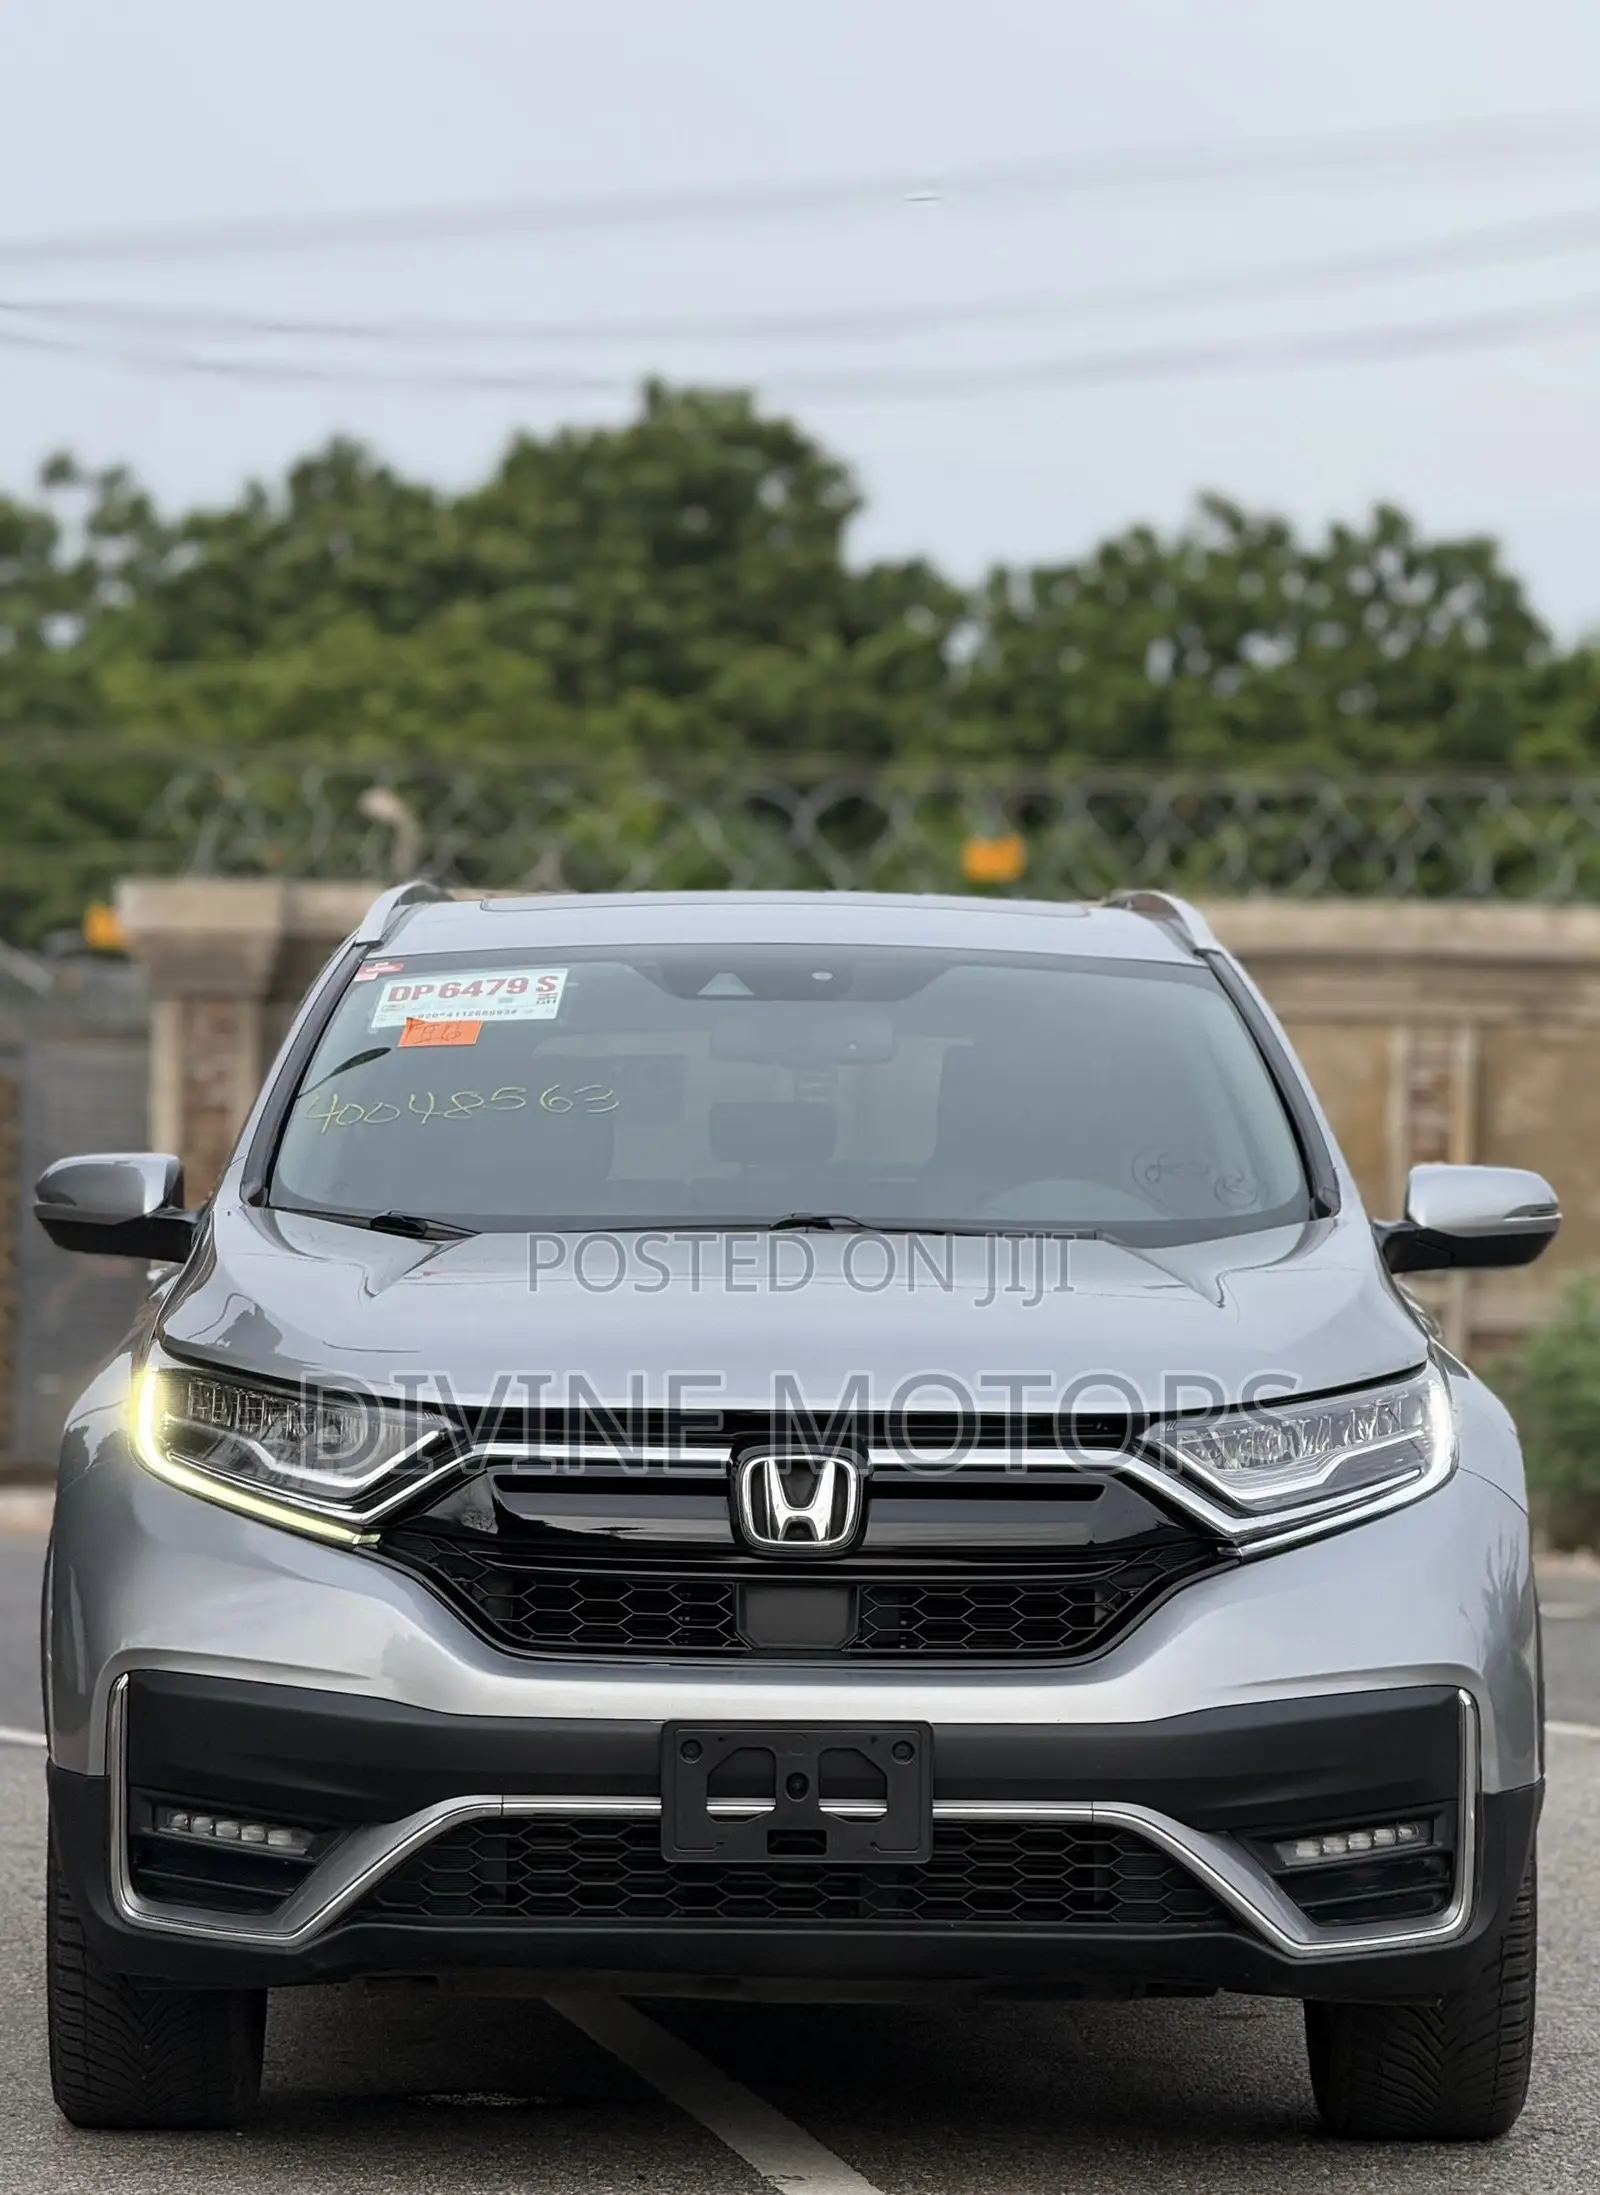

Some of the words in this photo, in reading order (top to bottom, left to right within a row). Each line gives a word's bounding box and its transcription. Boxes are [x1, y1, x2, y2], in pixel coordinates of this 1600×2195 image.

[387, 983, 435, 1003] DP
[437, 976, 530, 1001] 6479
[536, 975, 559, 993] S
[304, 1084, 620, 1134] 40048563
